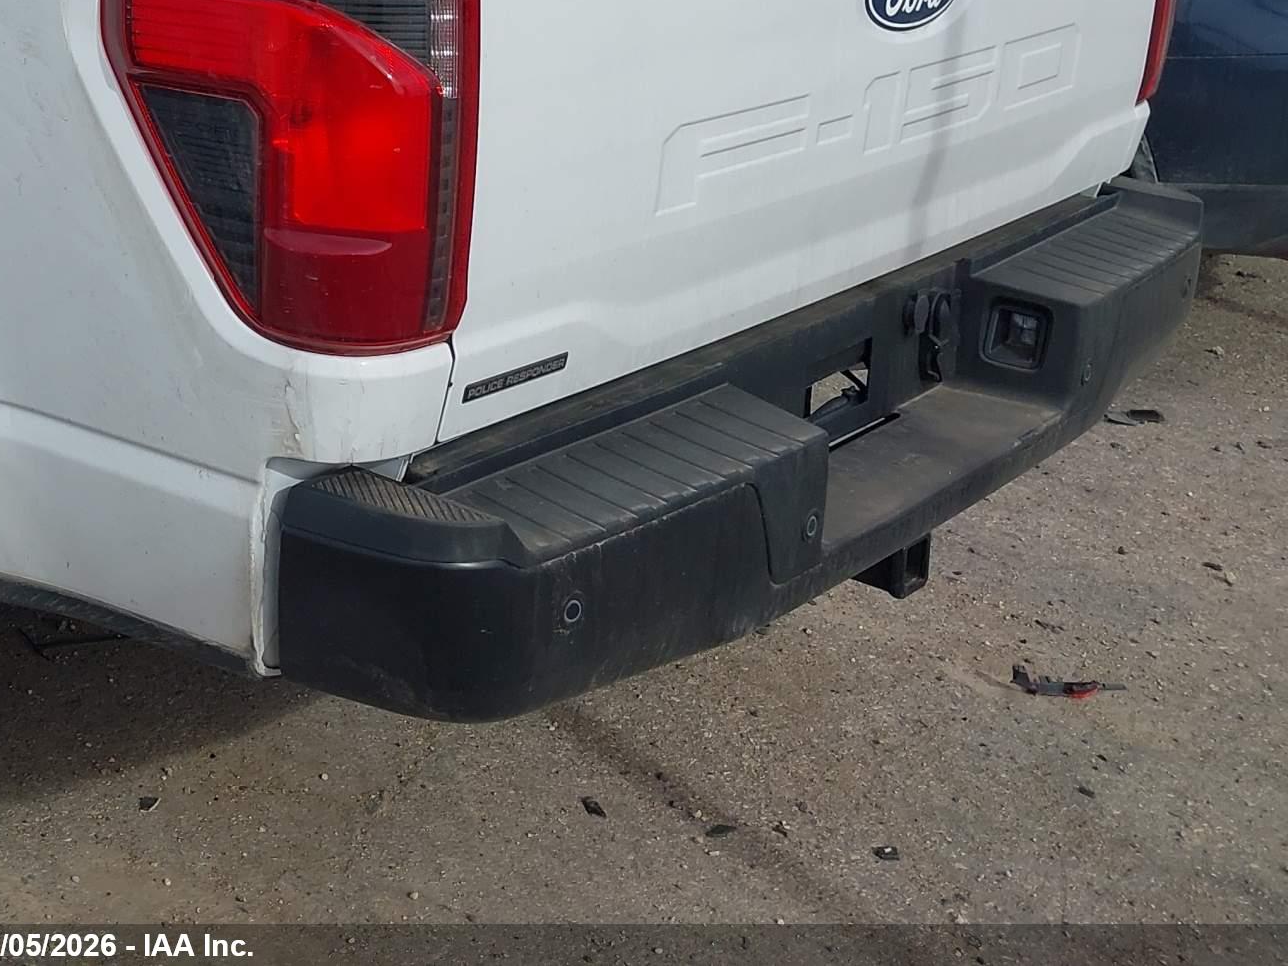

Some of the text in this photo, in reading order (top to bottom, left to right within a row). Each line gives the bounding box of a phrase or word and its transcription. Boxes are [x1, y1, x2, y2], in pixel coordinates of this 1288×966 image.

[654, 22, 1080, 216] F-150
[467, 358, 565, 399] POLICE RESPONDER
